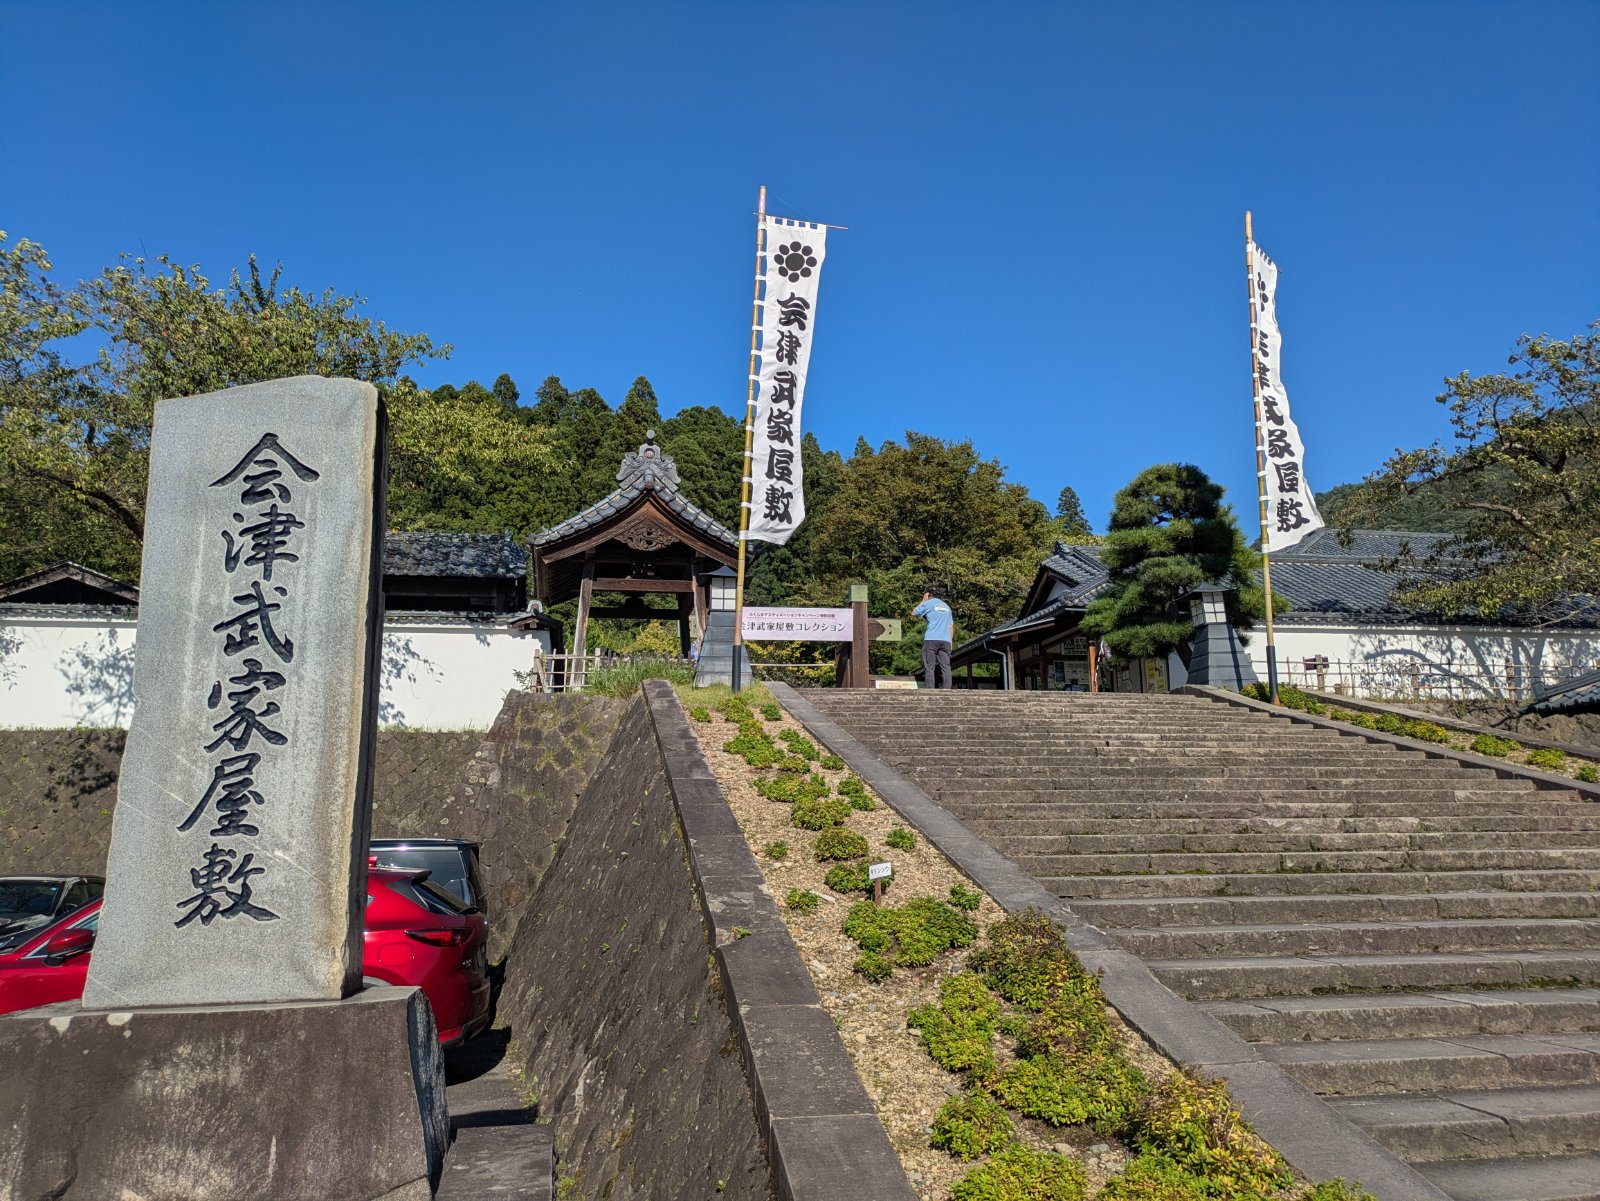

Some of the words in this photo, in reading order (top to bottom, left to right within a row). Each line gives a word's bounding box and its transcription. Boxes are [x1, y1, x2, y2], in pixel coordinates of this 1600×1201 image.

[763, 292, 811, 525] 会津武家屋敷
[174, 431, 320, 929] 会津武家屋敷
